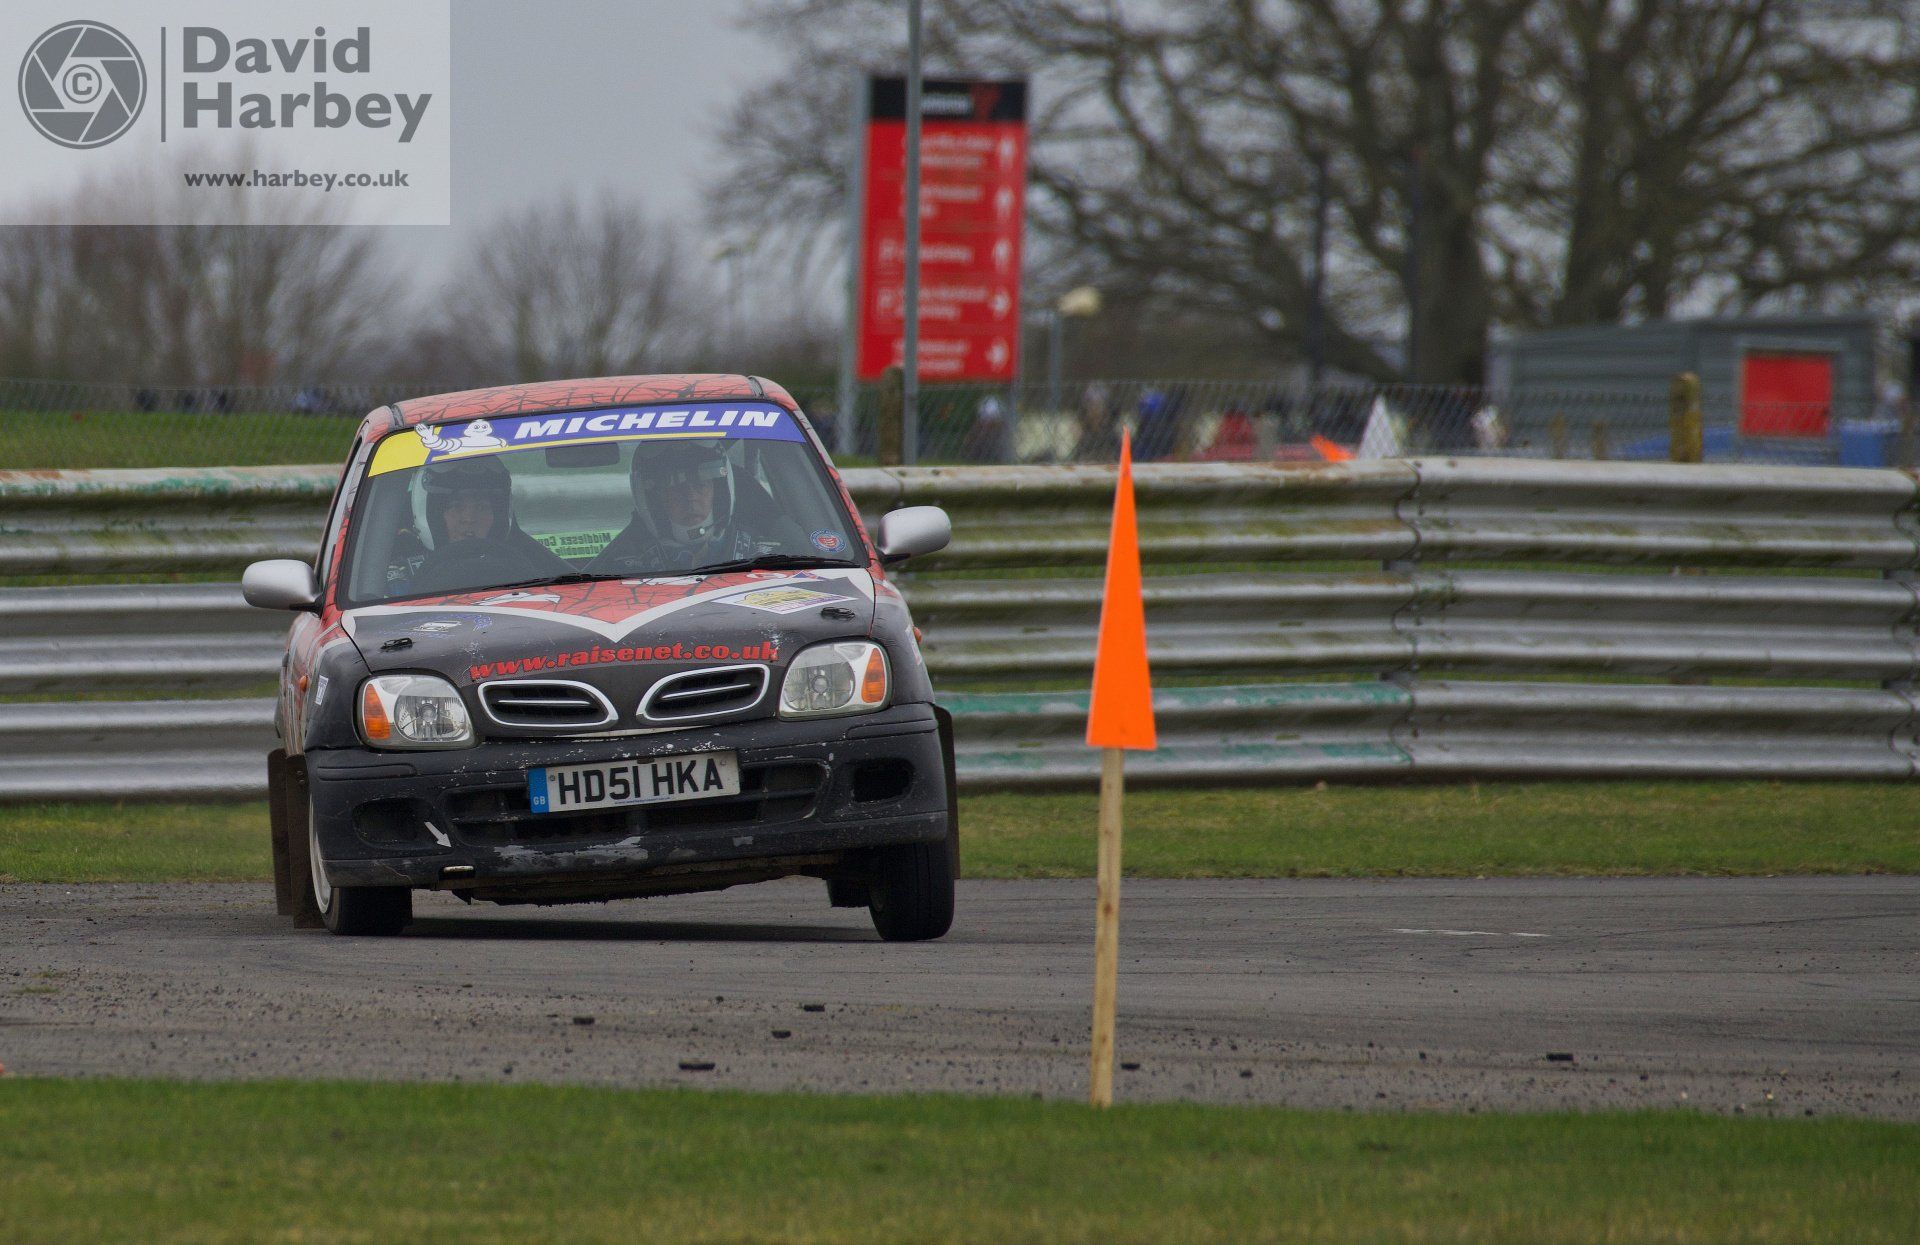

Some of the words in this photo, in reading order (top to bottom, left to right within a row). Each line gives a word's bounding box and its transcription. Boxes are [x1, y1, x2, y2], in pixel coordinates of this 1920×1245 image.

[560, 532, 611, 545] MICHELIN
[469, 640, 779, 680] www.raisenet.co.uk
[557, 765, 642, 805] HD51
[651, 758, 724, 796] HKA
[533, 796, 546, 806] GB
